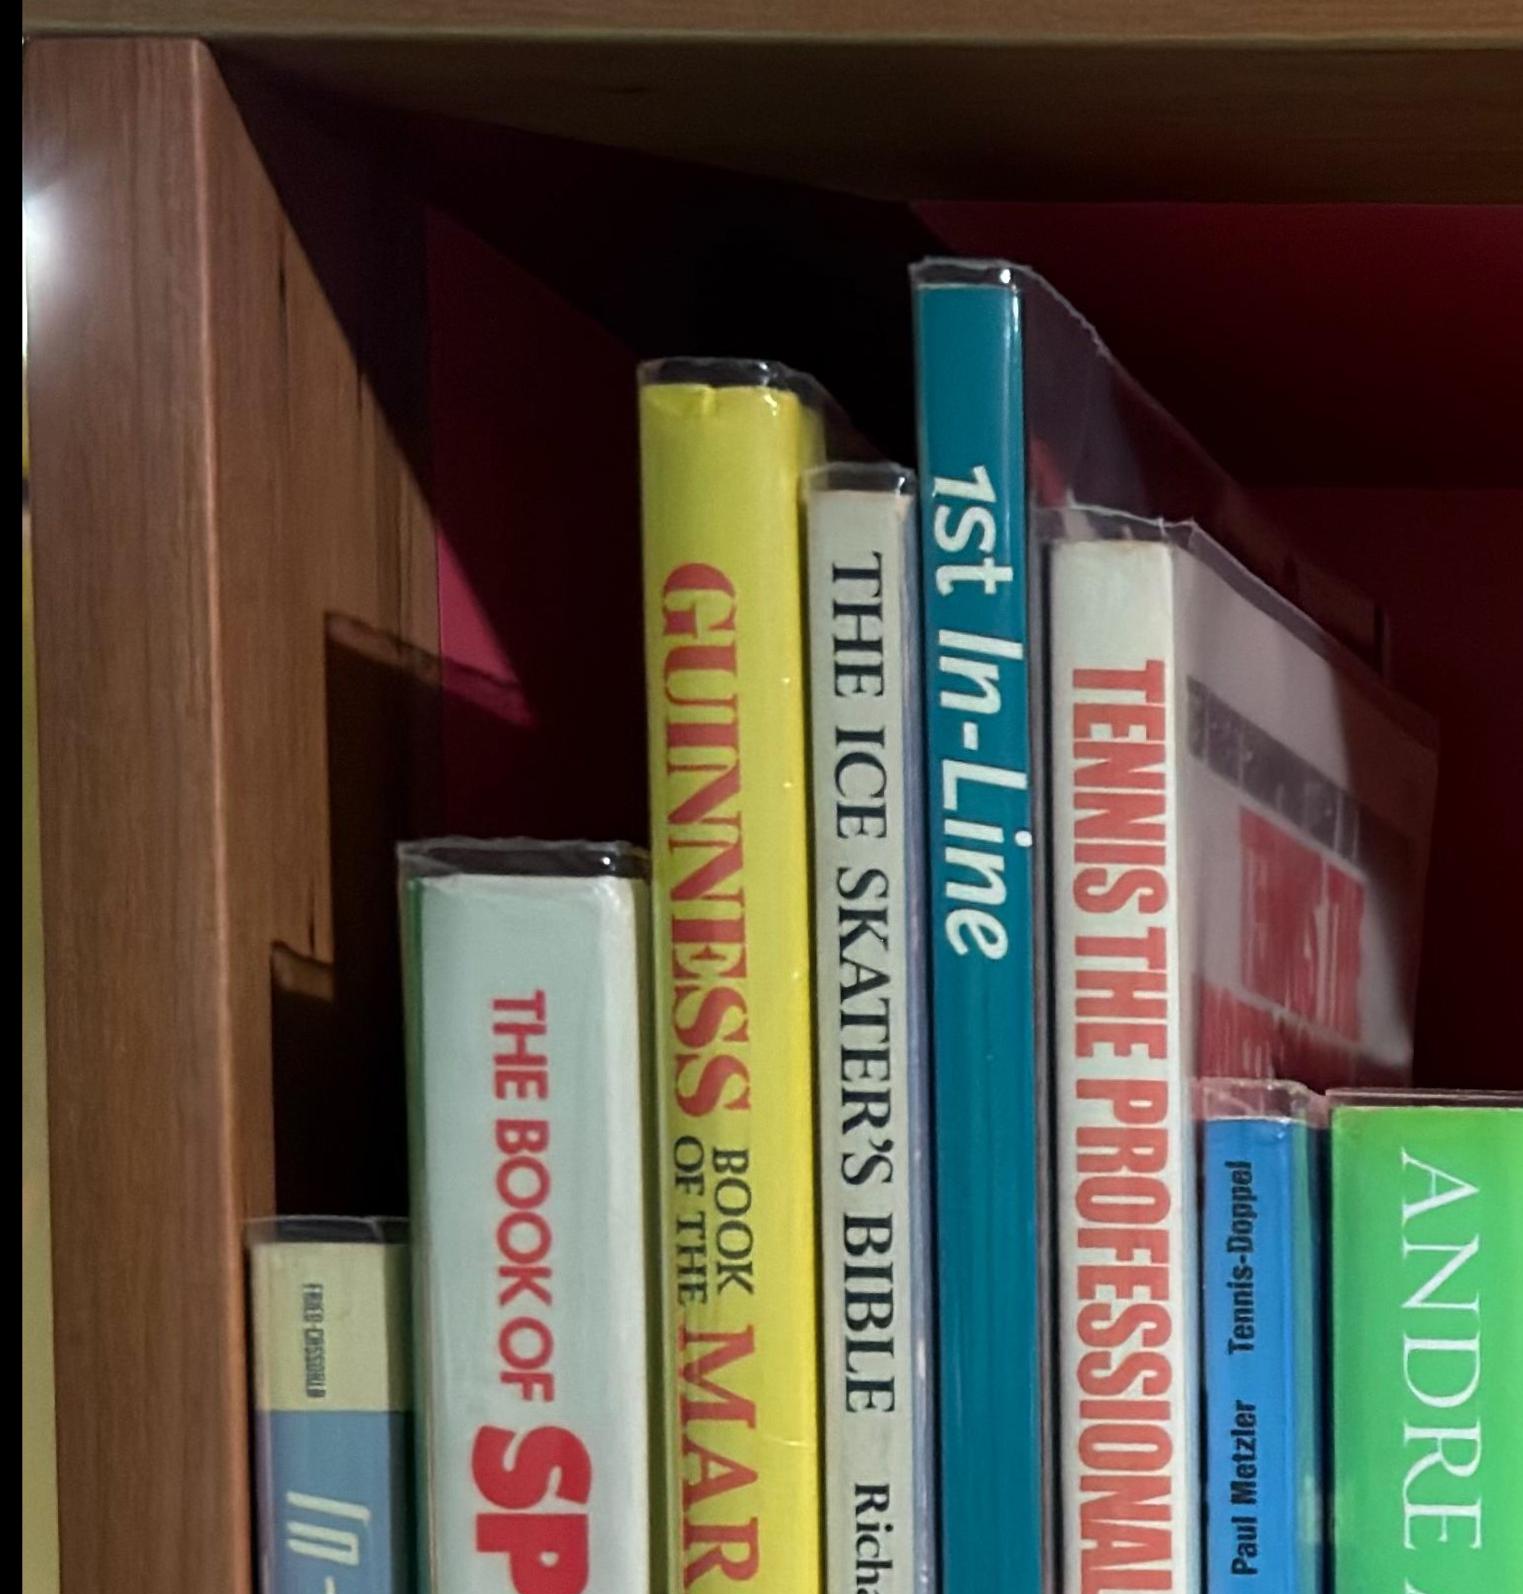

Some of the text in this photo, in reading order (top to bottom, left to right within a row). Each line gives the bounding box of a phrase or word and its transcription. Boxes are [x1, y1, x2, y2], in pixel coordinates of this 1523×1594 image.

[932, 464, 1033, 961] 1st In-Line
[1072, 659, 1168, 914] TENNIS
[662, 562, 751, 1118] GUINNESS
[491, 989, 549, 1101] THE
[831, 551, 896, 1414] THE ICE SKATER'S BIBLE
[1074, 926, 1168, 1059] THE
[495, 1120, 553, 1307] BOOK
[672, 1135, 708, 1309] OF THE
[712, 1148, 755, 1297] BOOK
[498, 1317, 554, 1403] OF
[1226, 1160, 1258, 1576] Paul Metzler Tennis-Doppel
[1401, 1148, 1482, 1550] ANDRE
